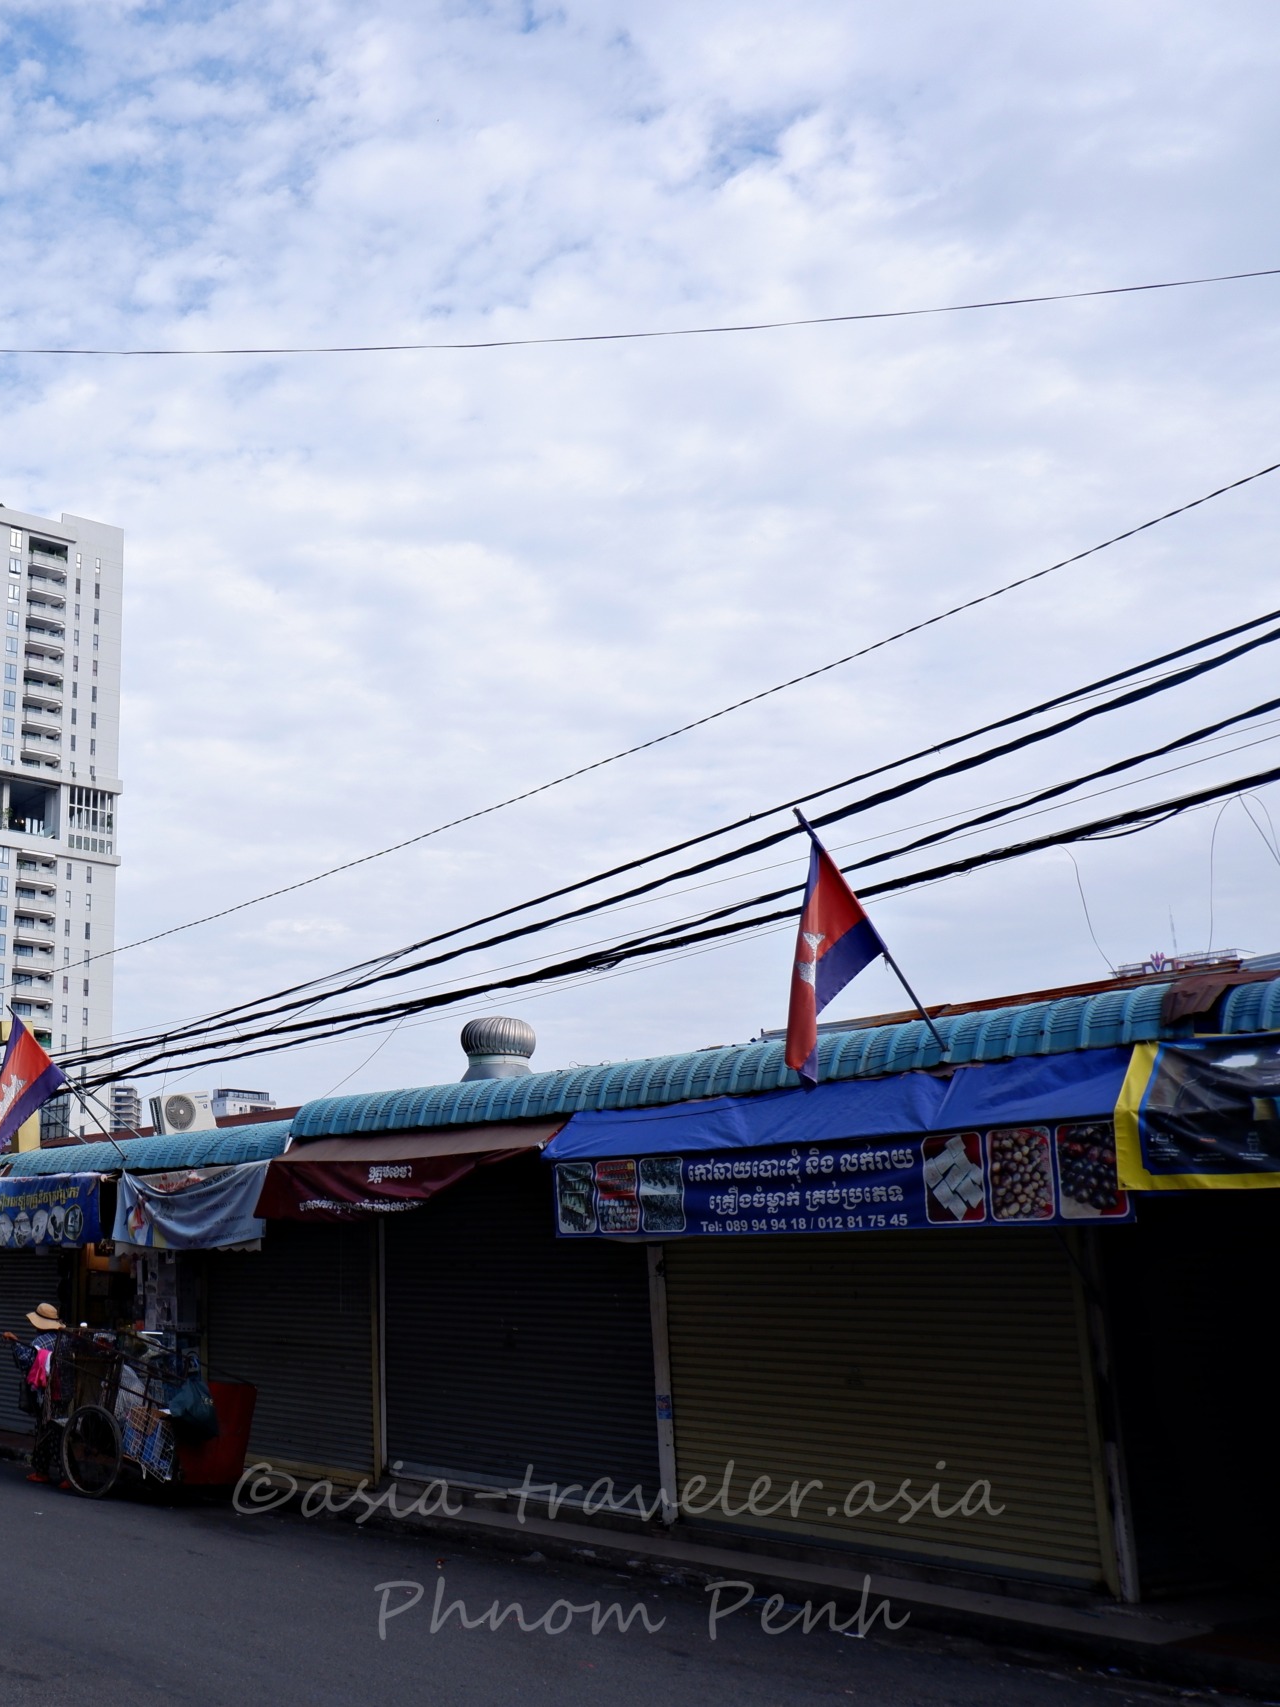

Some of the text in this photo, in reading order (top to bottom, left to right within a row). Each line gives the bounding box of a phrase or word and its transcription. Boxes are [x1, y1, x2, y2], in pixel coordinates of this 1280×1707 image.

[805, 1147, 834, 1175] និង
[840, 1143, 915, 1172] លក់រាយ
[805, 1181, 904, 1211] គ្រប់ប្រភេទ
[701, 1221, 722, 1233] Tel:
[726, 1220, 748, 1232] 089
[752, 1219, 768, 1231] 94
[771, 1218, 787, 1231] 94
[791, 1217, 807, 1230] 18
[818, 1216, 842, 1229] 012
[847, 1215, 863, 1228] 81
[868, 1214, 886, 1227] 75
[889, 1213, 908, 1226] 45
